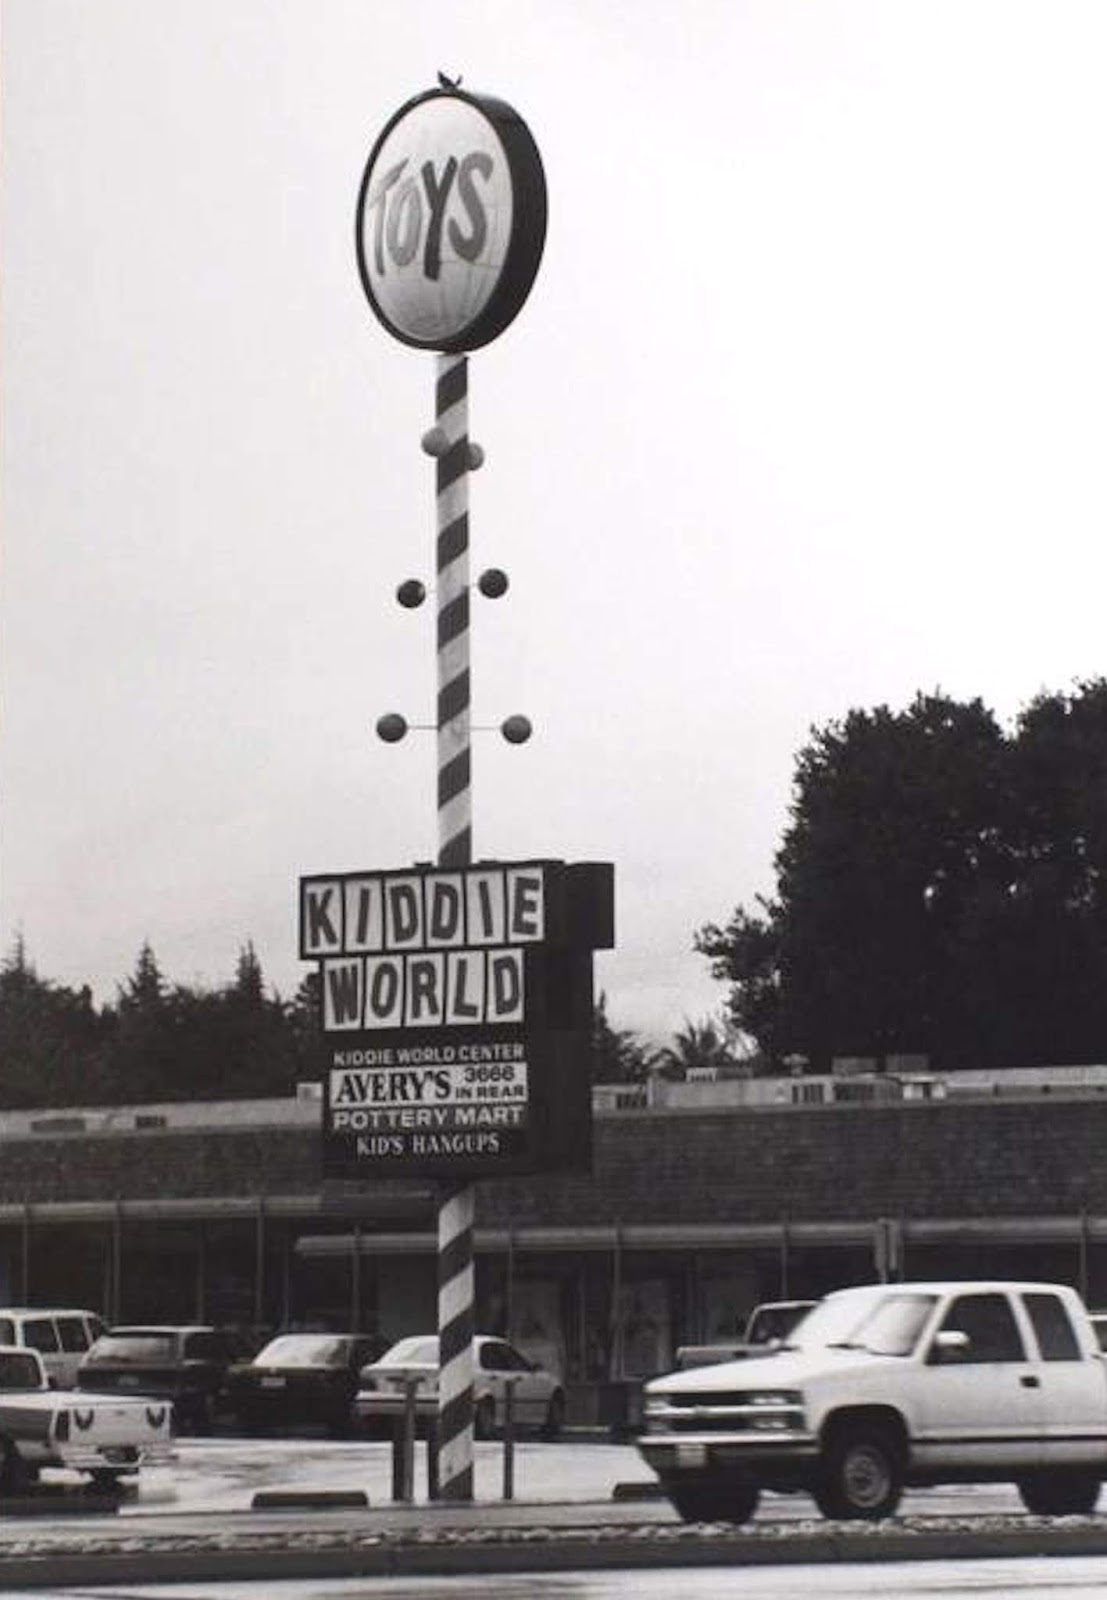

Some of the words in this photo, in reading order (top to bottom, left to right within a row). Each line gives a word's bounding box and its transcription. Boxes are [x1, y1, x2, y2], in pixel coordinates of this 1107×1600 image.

[370, 152, 494, 281] TOYS
[307, 876, 541, 948] KIDDIE
[328, 955, 520, 1025] WORLD
[333, 1048, 395, 1066] KIDDIE
[397, 1046, 456, 1063] WORLD
[458, 1043, 525, 1061] CENTER
[334, 1070, 451, 1102] AVERY'S
[455, 1086, 472, 1099] IN
[477, 1084, 524, 1098] REAR
[333, 1108, 448, 1130] POTTERY
[454, 1104, 523, 1126] MART
[412, 1132, 499, 1154] HANGUPS
